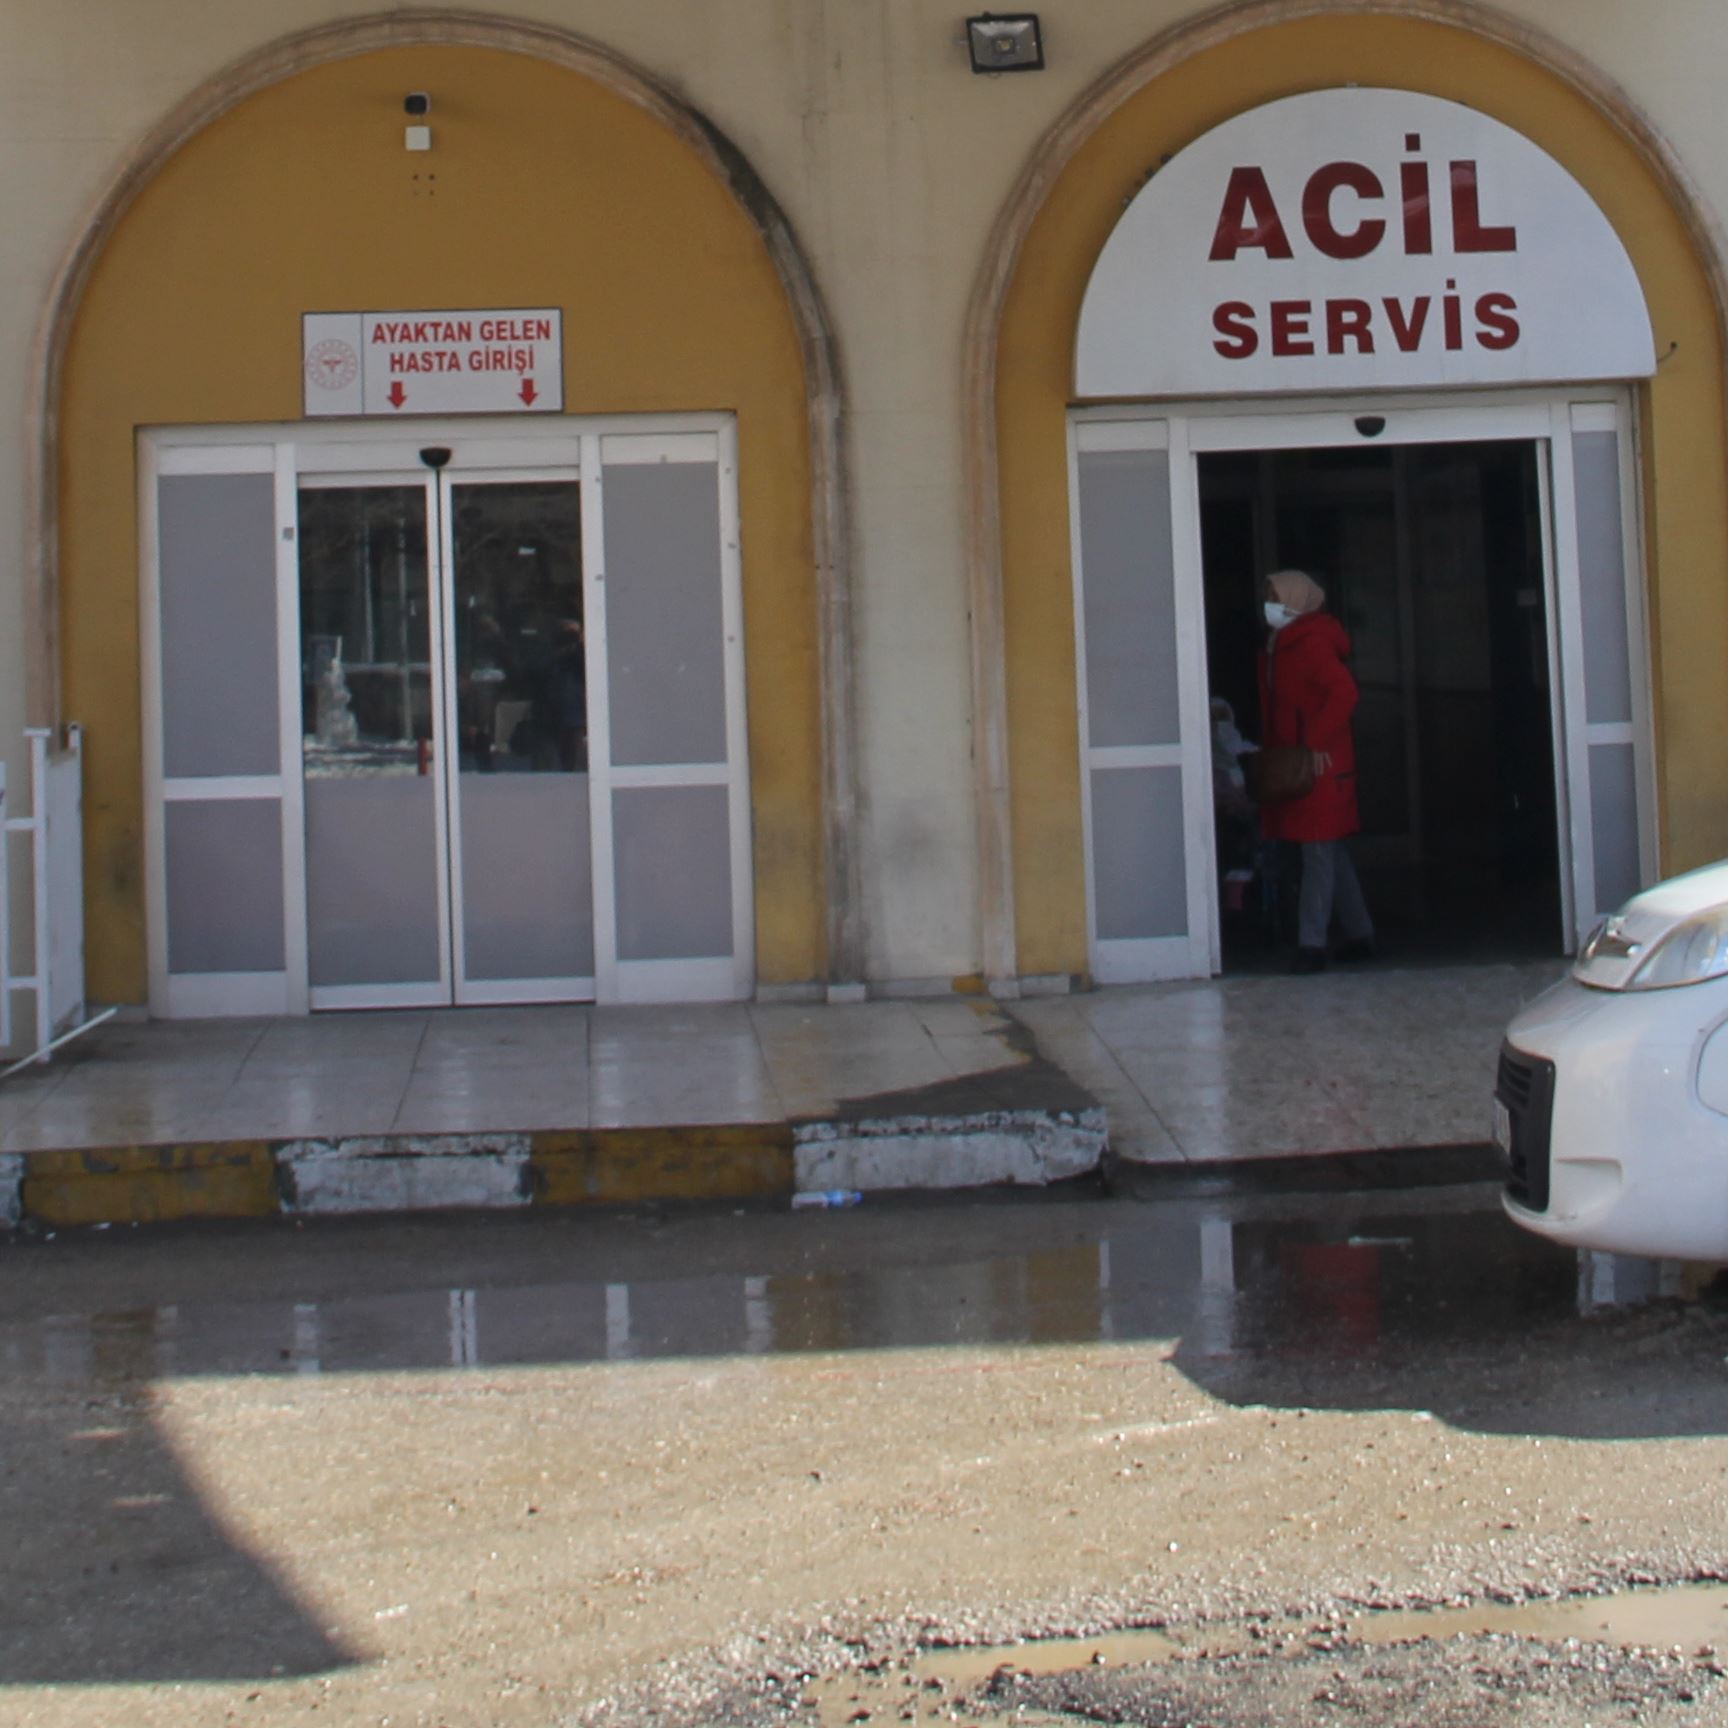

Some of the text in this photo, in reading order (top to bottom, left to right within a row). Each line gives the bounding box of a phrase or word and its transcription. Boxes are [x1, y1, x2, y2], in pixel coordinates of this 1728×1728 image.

[1208, 133, 1517, 261] ACİL
[372, 319, 551, 344] AYAKTAN GELEN
[1212, 278, 1520, 360] SERVİS
[389, 344, 535, 376] HASTA GİRİŞİ
